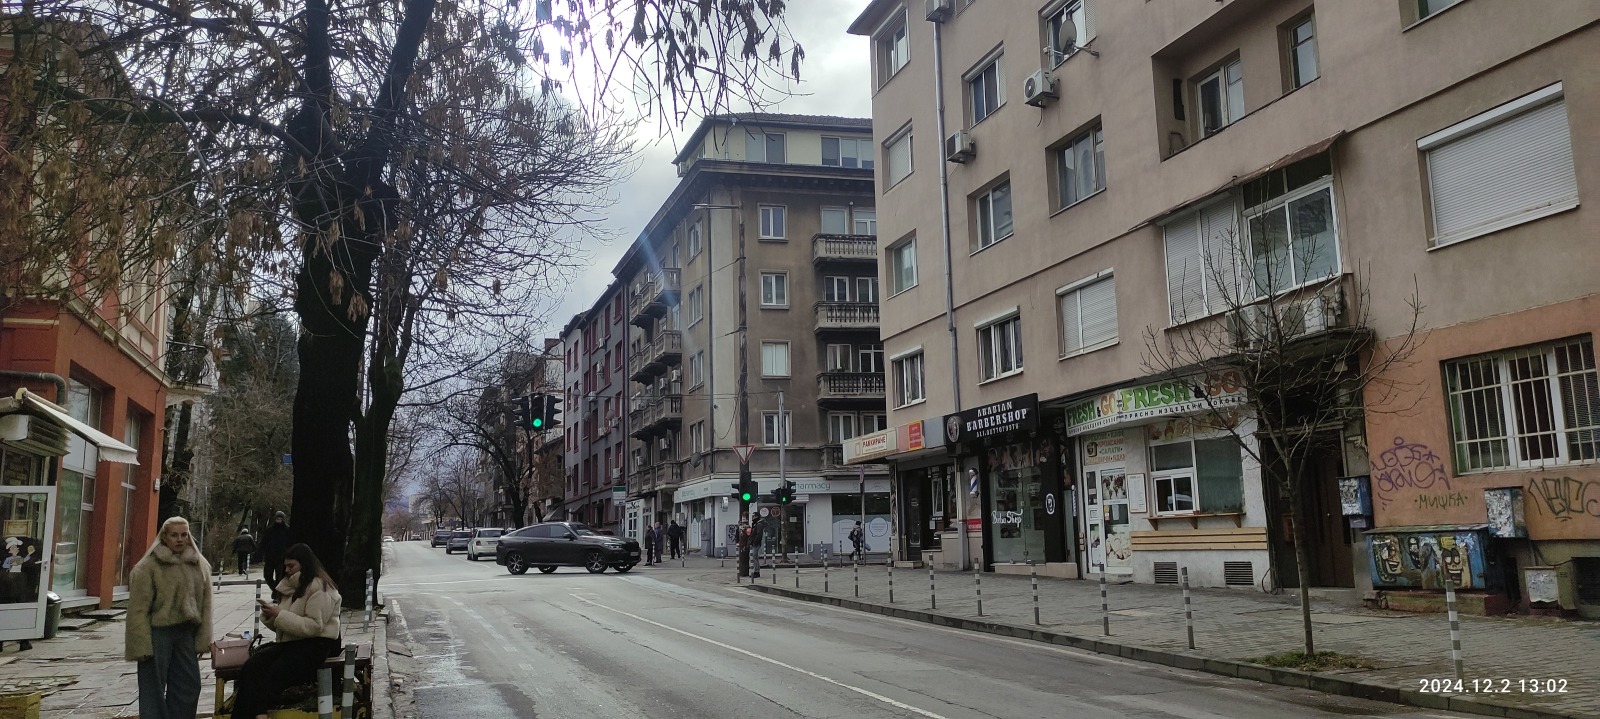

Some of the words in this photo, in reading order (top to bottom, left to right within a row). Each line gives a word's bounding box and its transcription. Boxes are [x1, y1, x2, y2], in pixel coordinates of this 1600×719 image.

[1120, 382, 1191, 412] FRESH
[1207, 396, 1242, 407] ОКОВЕ
[966, 408, 1027, 432] BARBERSHOP
[977, 401, 1013, 417] ARABIAN
[1066, 400, 1097, 427] FRESH
[1101, 393, 1117, 416] GO
[1006, 508, 1024, 528] Shop
